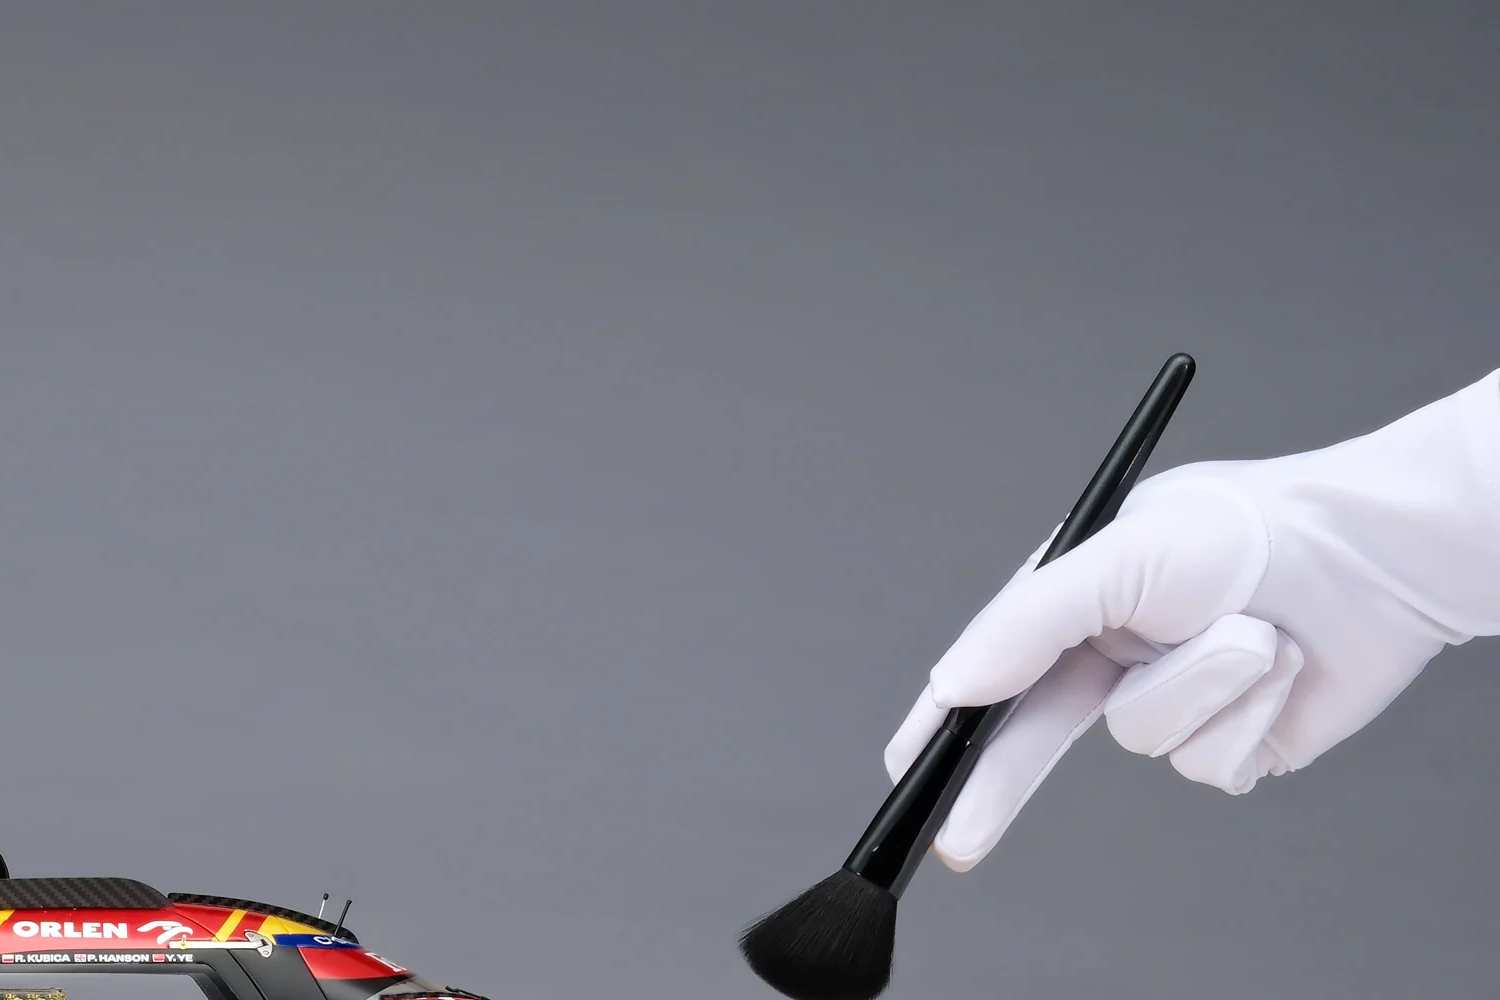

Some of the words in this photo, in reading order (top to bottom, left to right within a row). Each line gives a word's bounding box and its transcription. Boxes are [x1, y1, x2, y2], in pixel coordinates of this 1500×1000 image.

[12, 920, 128, 939] ORLEN
[15, 953, 26, 963] R.
[27, 953, 71, 963] KUBICA
[87, 953, 98, 963] P.
[101, 953, 150, 963] HANSON
[165, 953, 177, 963] Y.
[179, 953, 194, 963] YE
